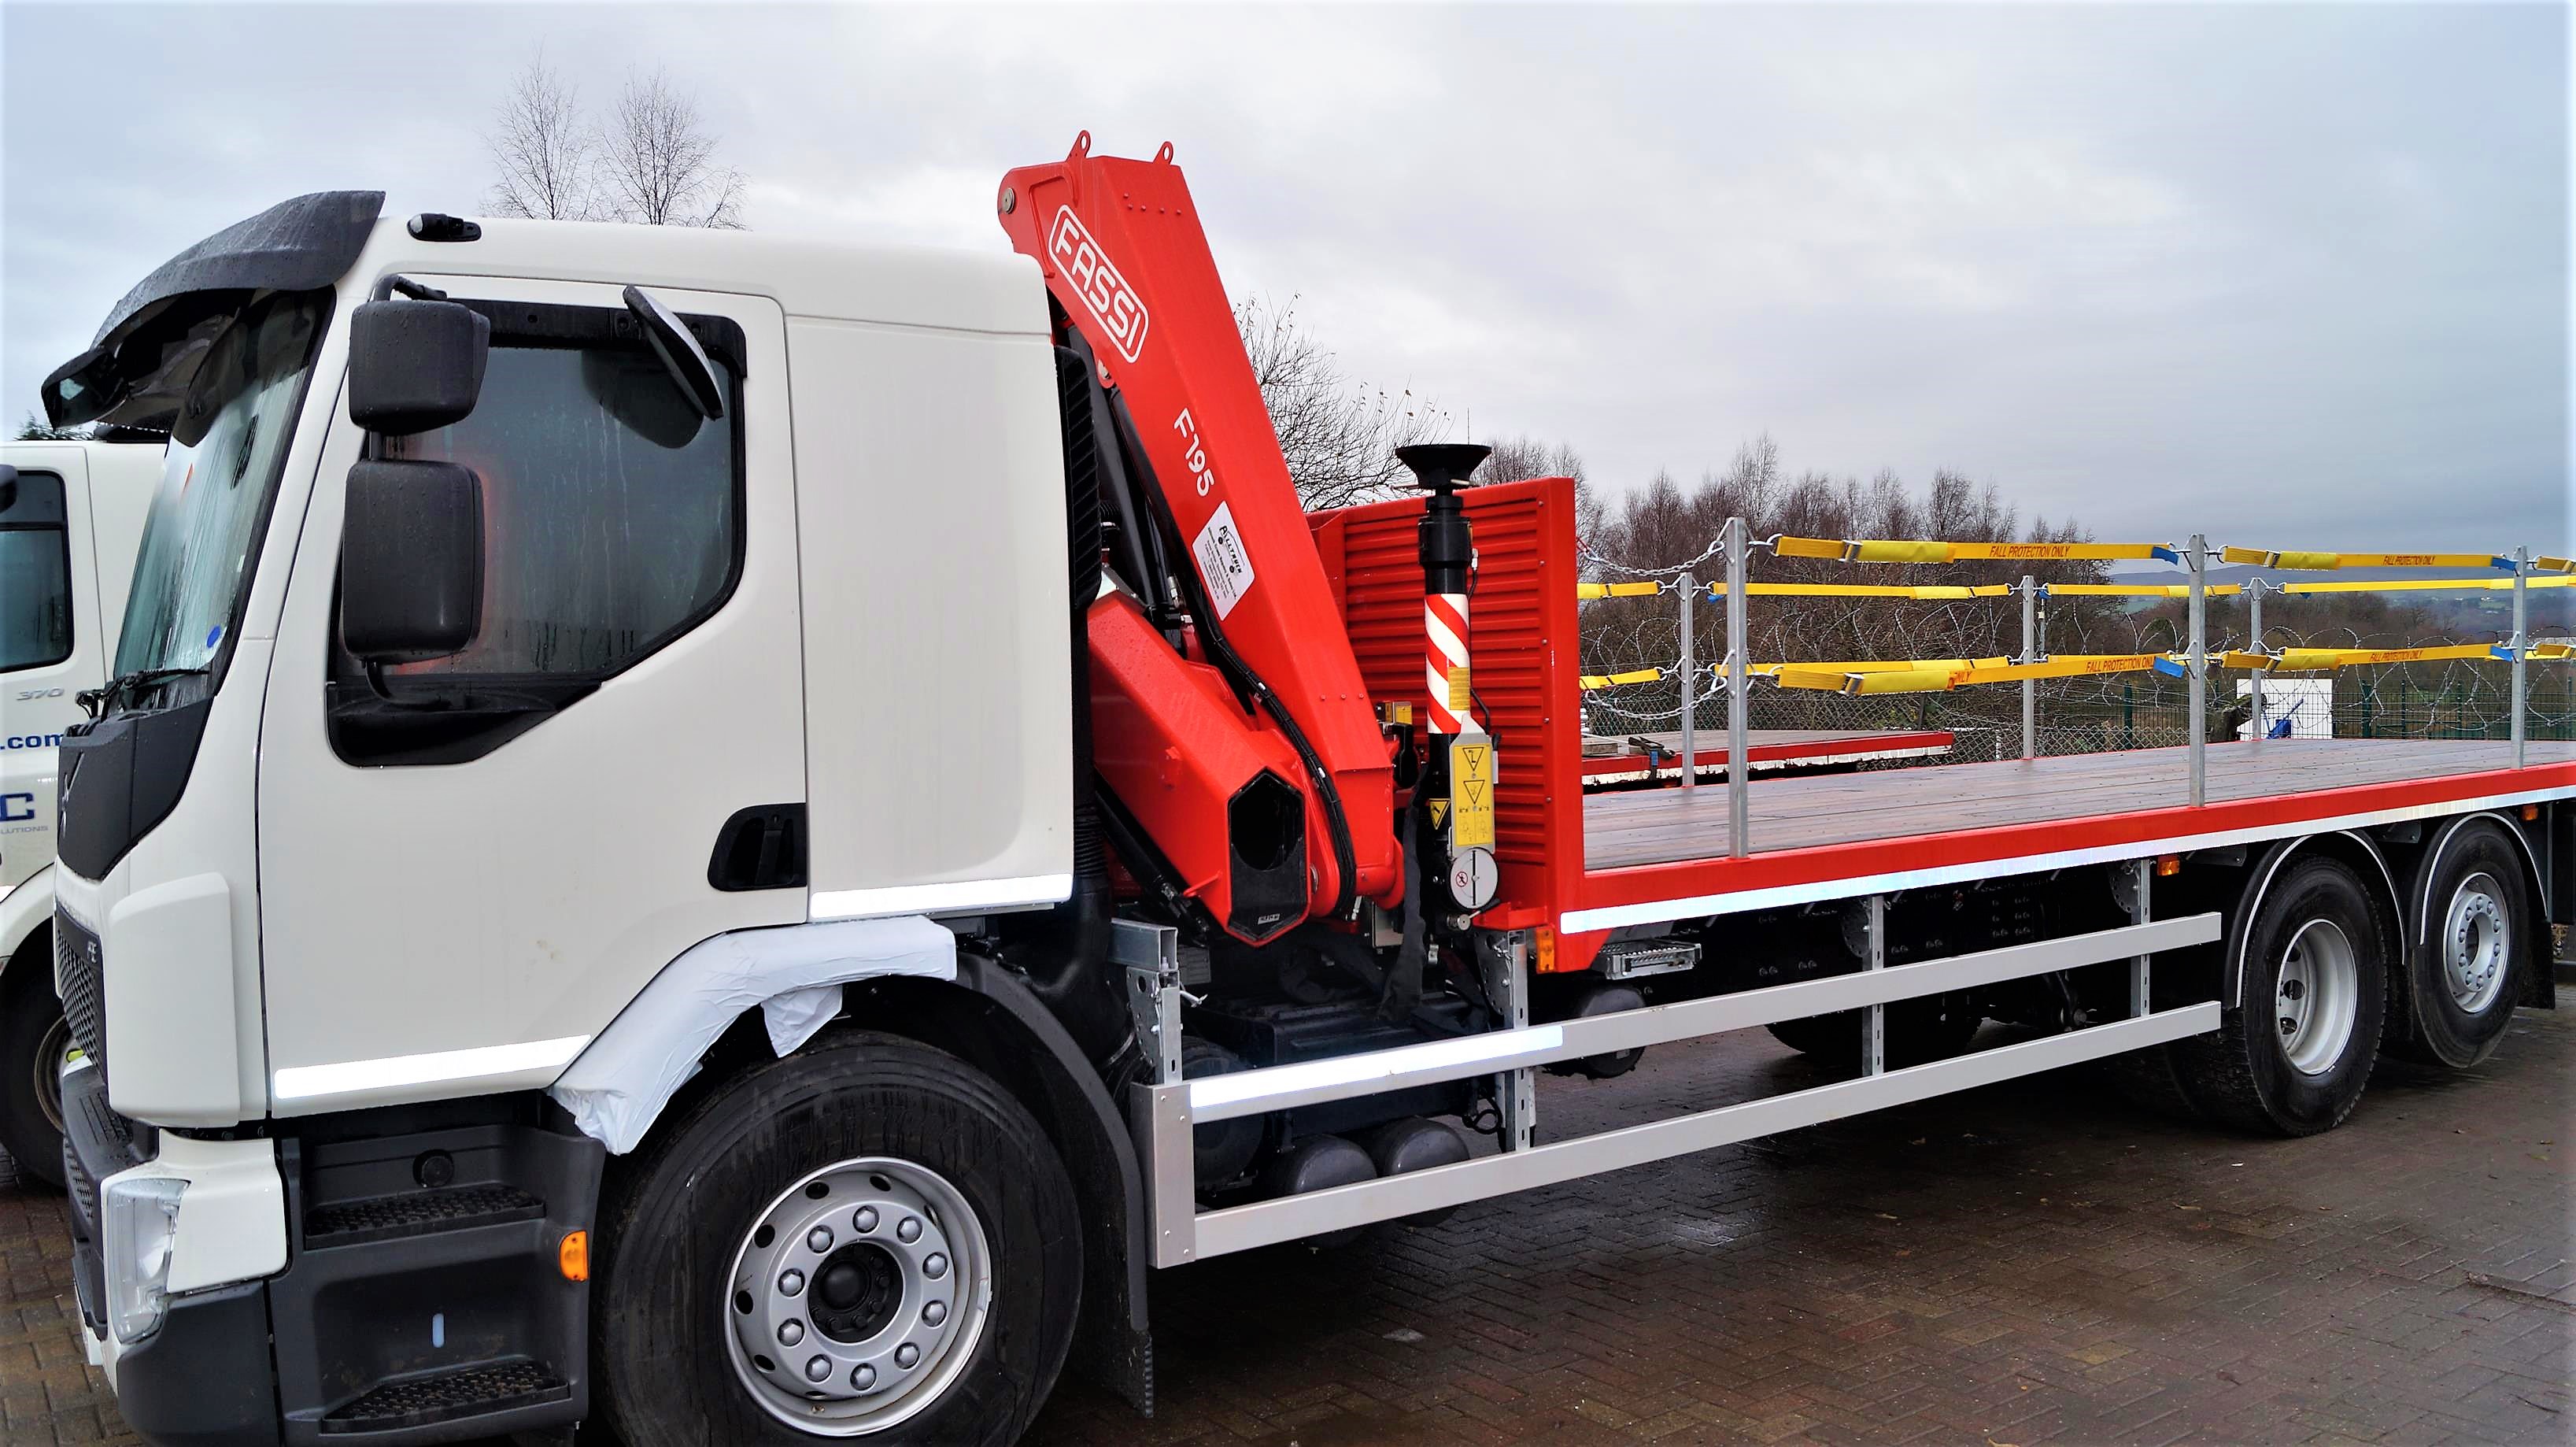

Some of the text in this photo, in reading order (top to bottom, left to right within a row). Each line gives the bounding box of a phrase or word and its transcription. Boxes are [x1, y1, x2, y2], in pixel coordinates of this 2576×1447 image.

[1055, 217, 1141, 350] FASSI
[1173, 408, 1214, 496] F195
[1990, 546, 2070, 557] FALL PROTECTION ONLY
[2382, 555, 2435, 565] FALL PROTECTION ONLY
[2369, 649, 2423, 661] FALL PROTECTION ONLY
[2086, 661, 2101, 672] FALL
[2102, 657, 2141, 671] PROTECTION
[17, 687, 65, 701] 370
